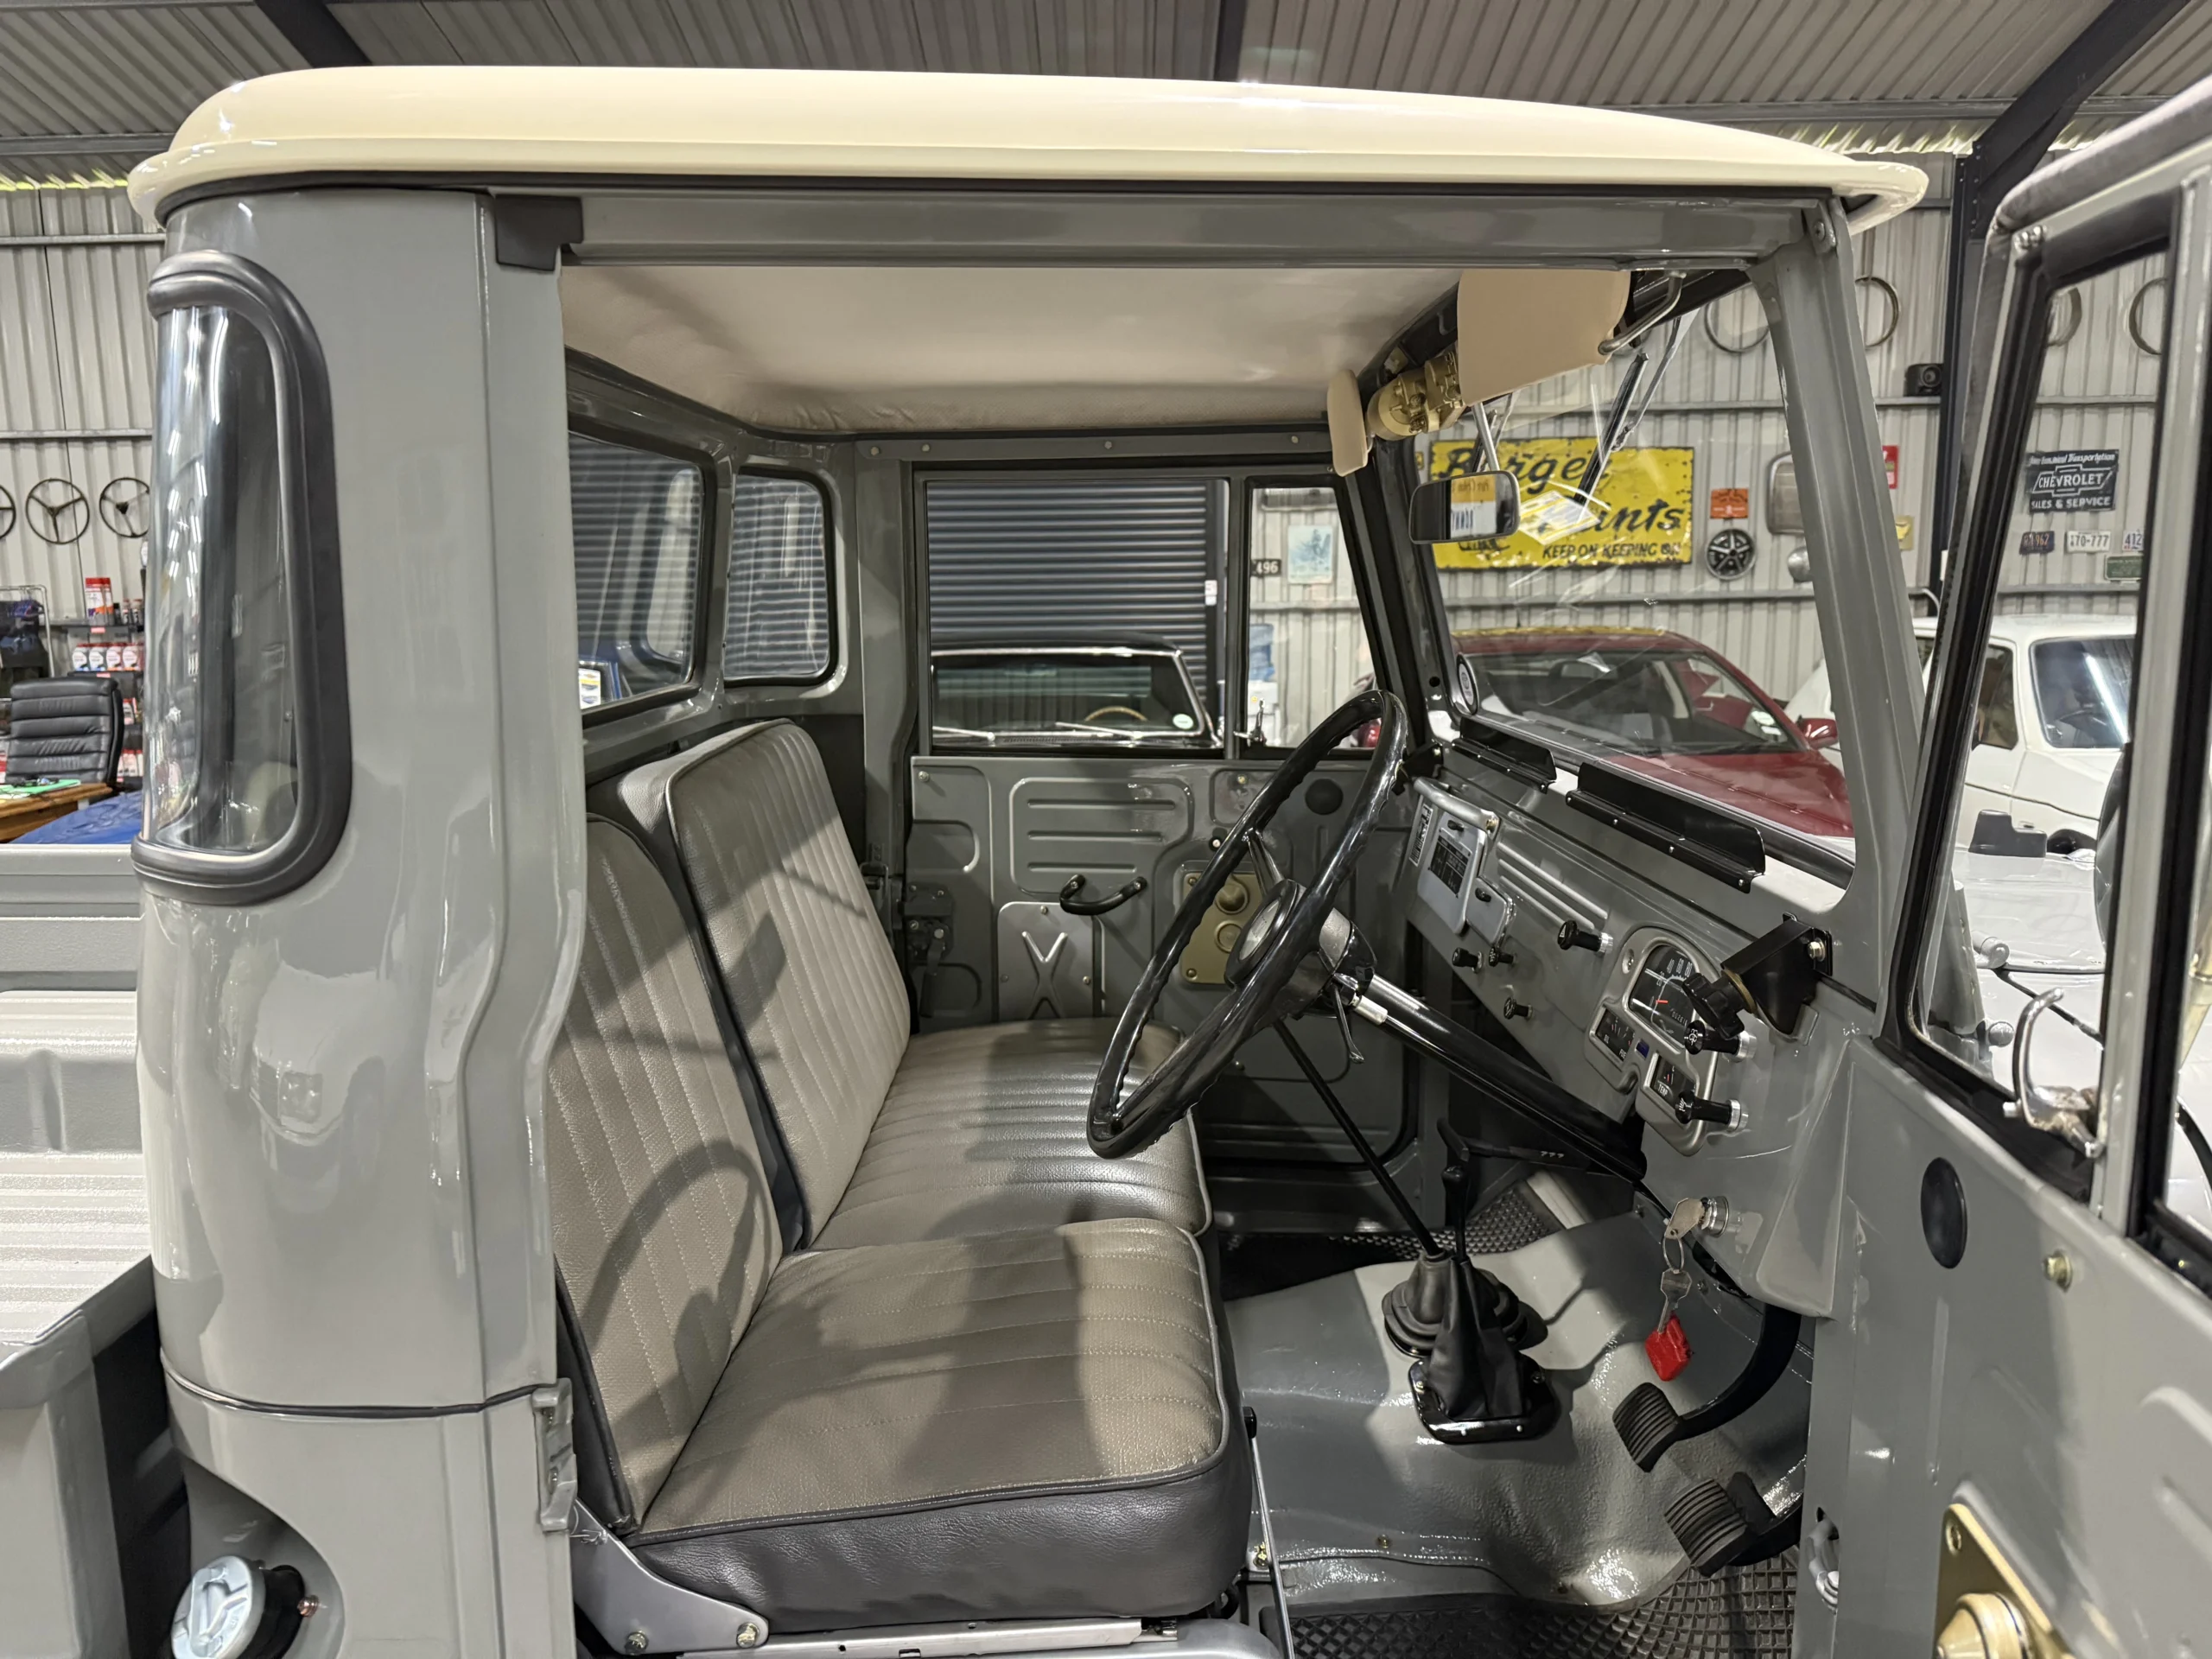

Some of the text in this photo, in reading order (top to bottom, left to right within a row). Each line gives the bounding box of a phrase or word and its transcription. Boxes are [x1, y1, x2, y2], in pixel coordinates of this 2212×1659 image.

[1431, 447, 1612, 495] Brge
[2038, 473, 2104, 489] CHEVROLET
[2031, 499, 2052, 510] SALES
[2066, 496, 2111, 509] SERVICE
[1542, 543, 1575, 559] KEEP
[1578, 543, 1598, 556] ON
[1602, 543, 1657, 558] KEEPING
[1254, 560, 1279, 574] 496
